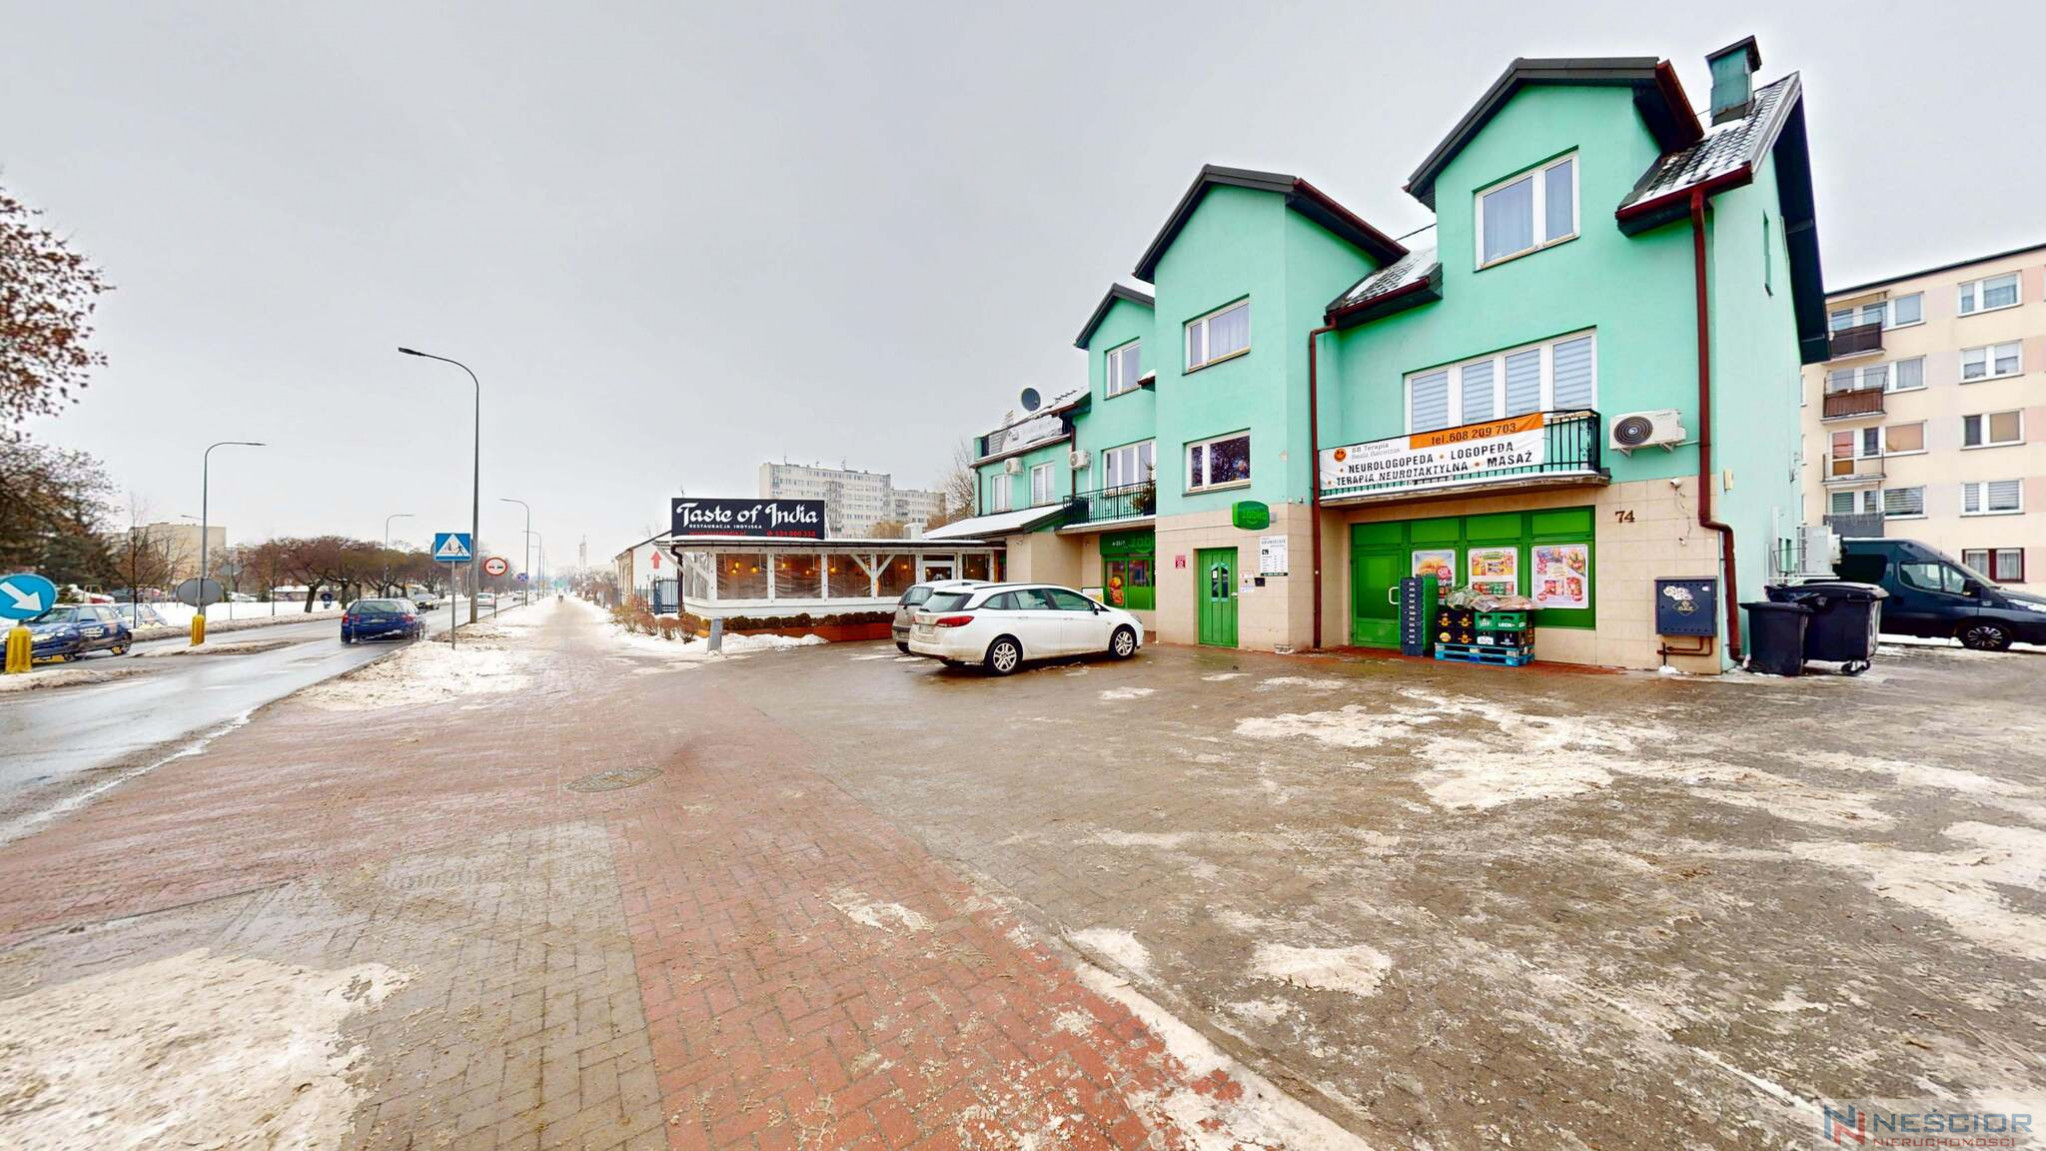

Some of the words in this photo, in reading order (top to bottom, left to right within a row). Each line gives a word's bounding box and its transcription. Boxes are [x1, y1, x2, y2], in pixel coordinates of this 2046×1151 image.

[1472, 427, 1492, 439] 209
[1496, 422, 1516, 434] 703
[1336, 473, 1375, 487] TERAPIA
[1378, 461, 1469, 481] NEUROTAKTYLNA
[1487, 450, 1533, 468] MASAŻ
[1348, 454, 1434, 474] NEUROLOGOPEDA
[1451, 441, 1514, 460] LOGOPEDA
[676, 502, 733, 527] Taste
[737, 504, 762, 524] of
[765, 503, 820, 528] India
[1615, 510, 1635, 523] 74
